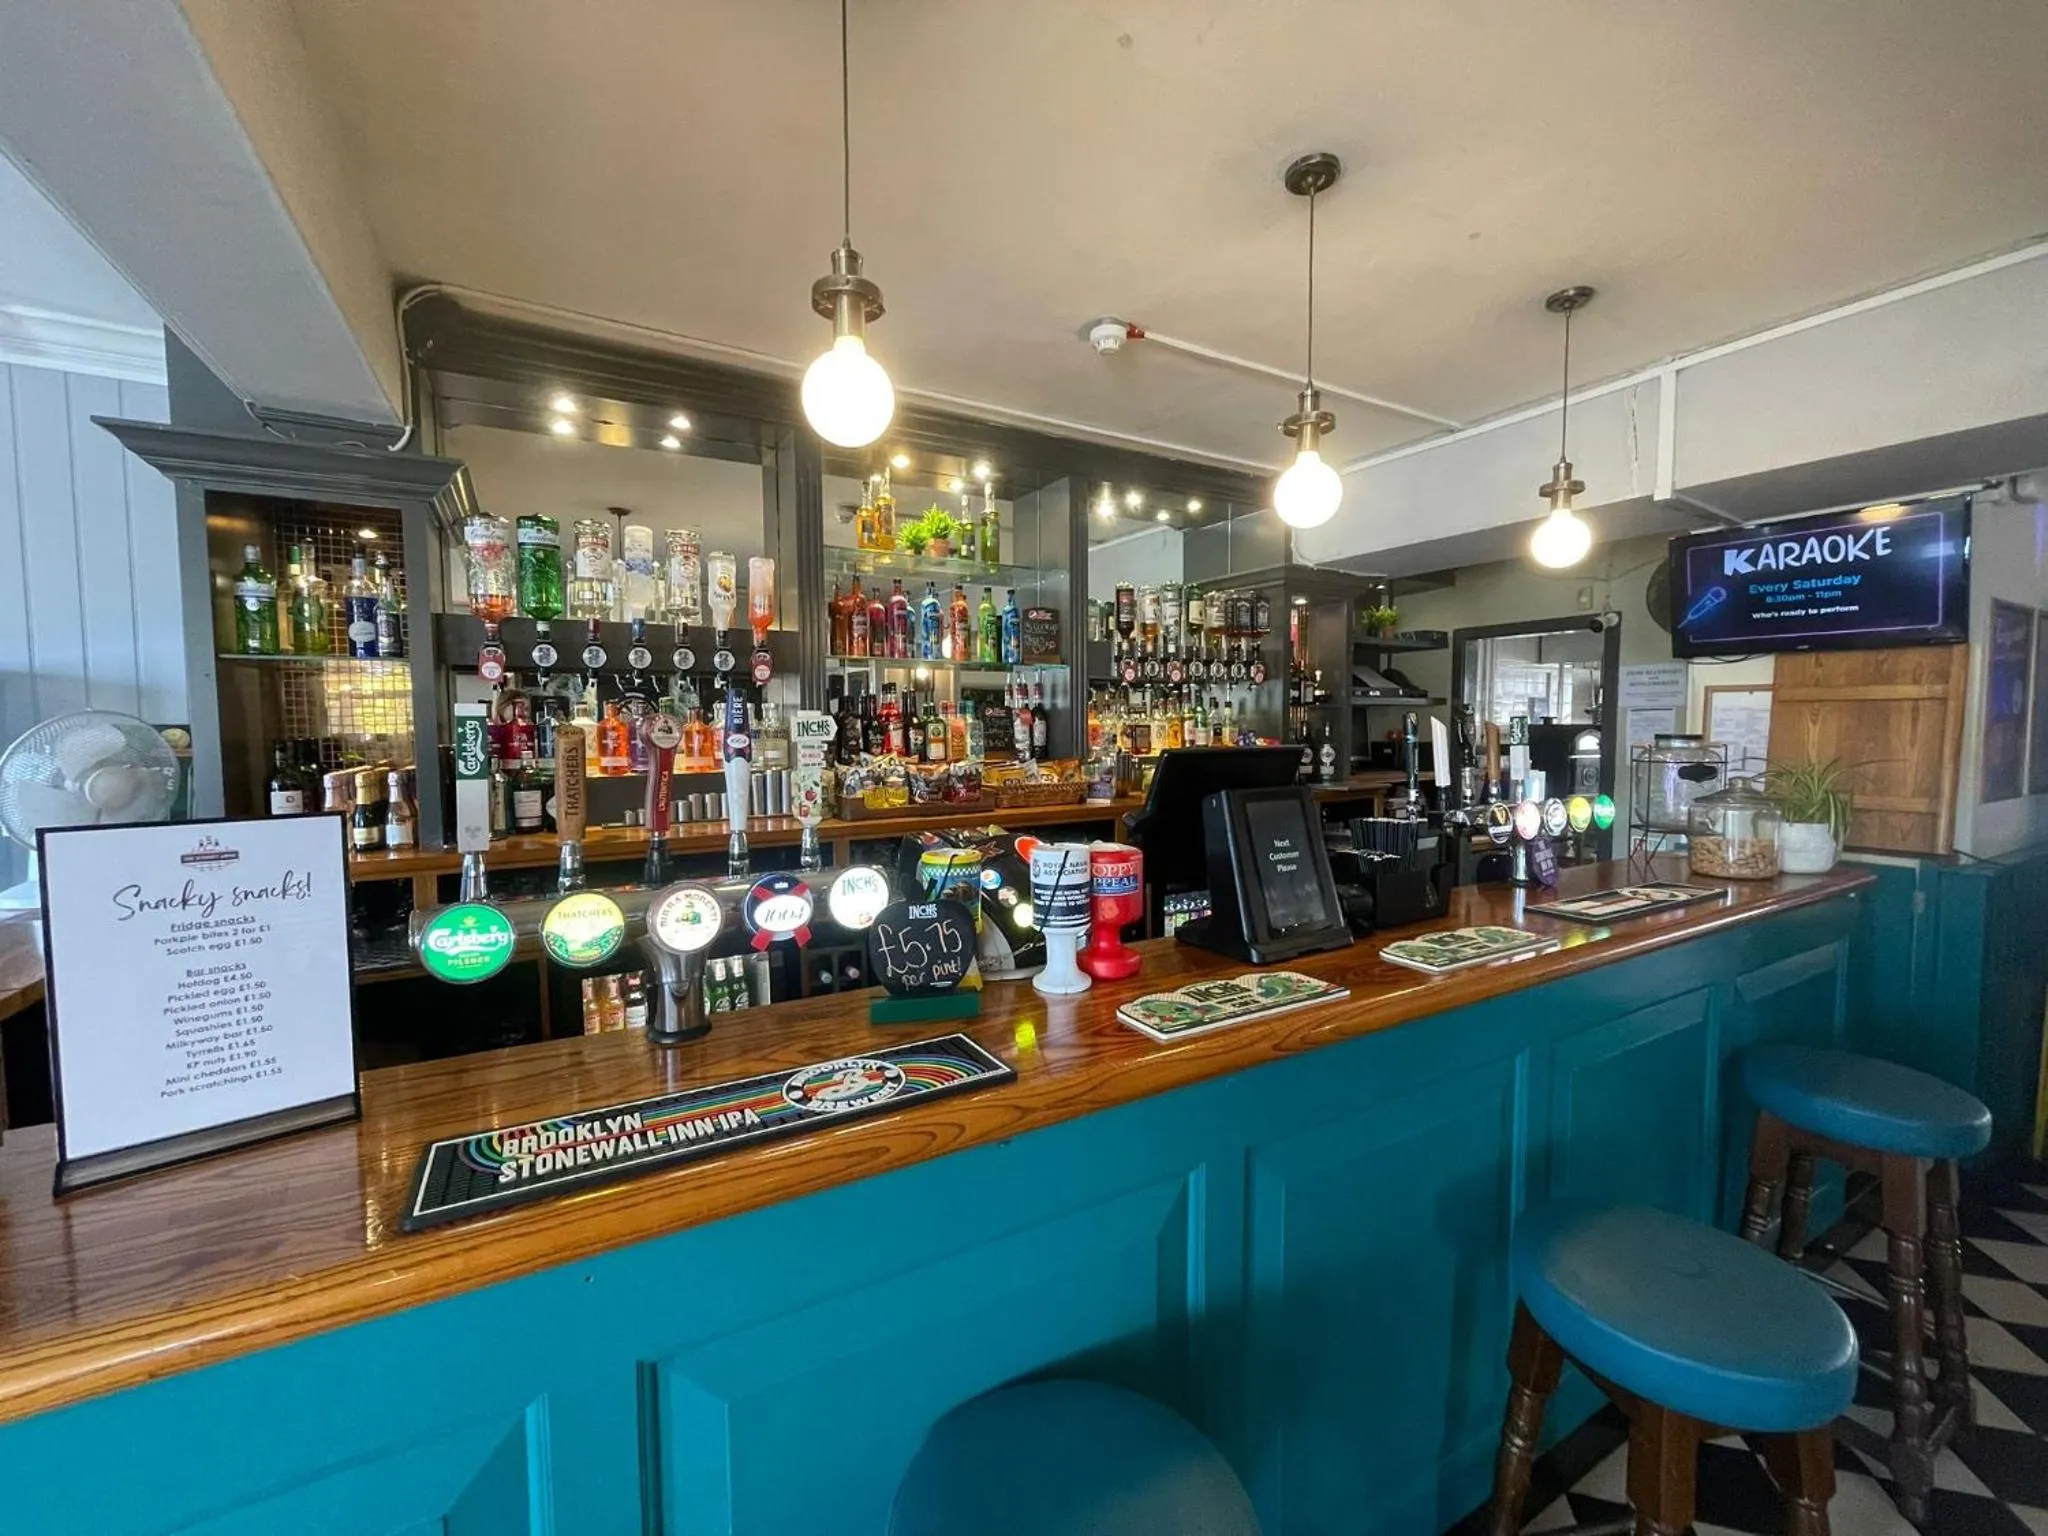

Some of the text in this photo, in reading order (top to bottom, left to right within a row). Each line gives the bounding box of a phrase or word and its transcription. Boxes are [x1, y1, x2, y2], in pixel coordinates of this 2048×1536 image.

[1724, 526, 1892, 576] KARAOKE
[1749, 575, 1861, 594] Every Saturday
[1752, 611, 1779, 620] Who's
[1820, 605, 1859, 614] perform
[733, 696, 743, 724] BIÈRE
[797, 721, 830, 737] INCH'S
[458, 720, 485, 775] Carlsberg
[565, 747, 579, 818] THATCHERS
[1270, 851, 1299, 861] Customer
[1092, 862, 1135, 877] OPPY
[1094, 877, 1137, 887] PPEAL
[112, 870, 312, 921] Snacky snacks!
[908, 903, 938, 919] INCH'S
[171, 915, 256, 933] Fridge snacks
[241, 927, 256, 935] for
[208, 942, 231, 951] egg
[428, 925, 511, 955] Carlsberg
[877, 919, 962, 977] £5.75
[902, 971, 925, 991] per
[932, 957, 962, 979] pint!
[213, 987, 235, 996] egg
[166, 1075, 191, 1086] Mini
[189, 1074, 253, 1092] scratchings
[502, 1112, 645, 1157] BROOKLYN
[499, 1108, 761, 1183] STONEWALL INN IPA
